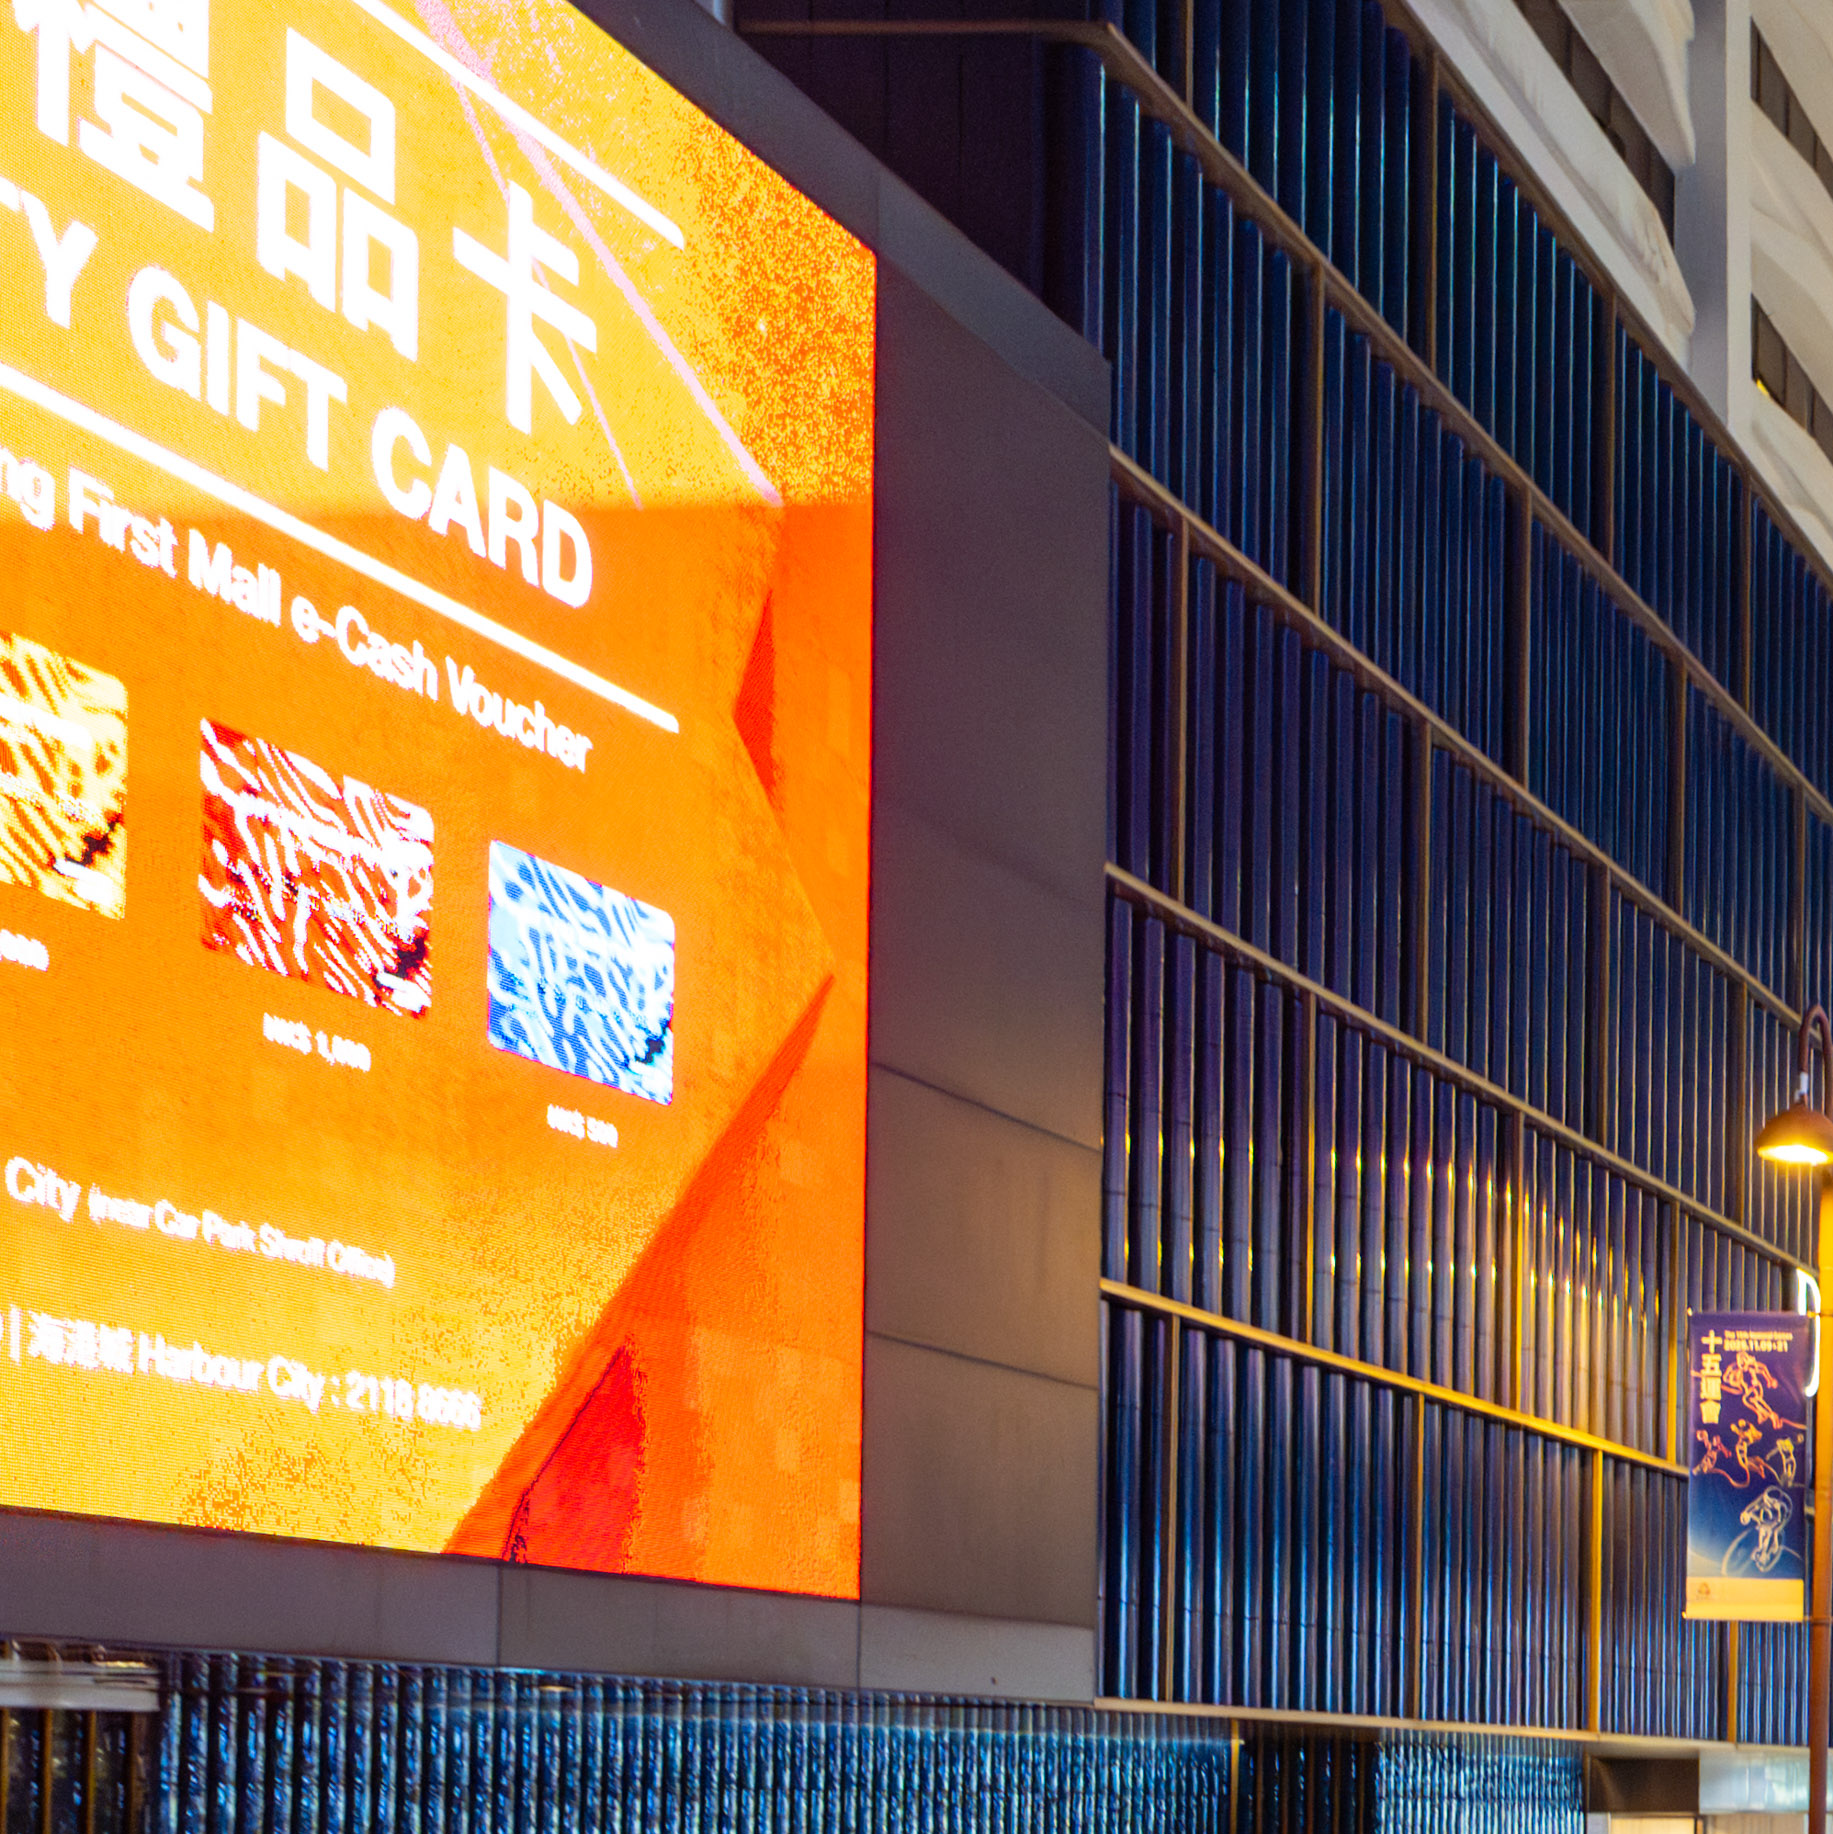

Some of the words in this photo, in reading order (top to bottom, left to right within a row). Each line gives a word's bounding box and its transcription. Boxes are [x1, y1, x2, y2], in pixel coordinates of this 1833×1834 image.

[127, 264, 347, 471] GIFT
[371, 406, 593, 608] CARD
[68, 465, 178, 578] First
[189, 528, 282, 627] Mall
[291, 604, 438, 701] e-Cash
[446, 656, 593, 773] Voucher
[5, 1156, 80, 1222] City
[139, 1332, 262, 1392] Harbour
[266, 1356, 326, 1413] City
